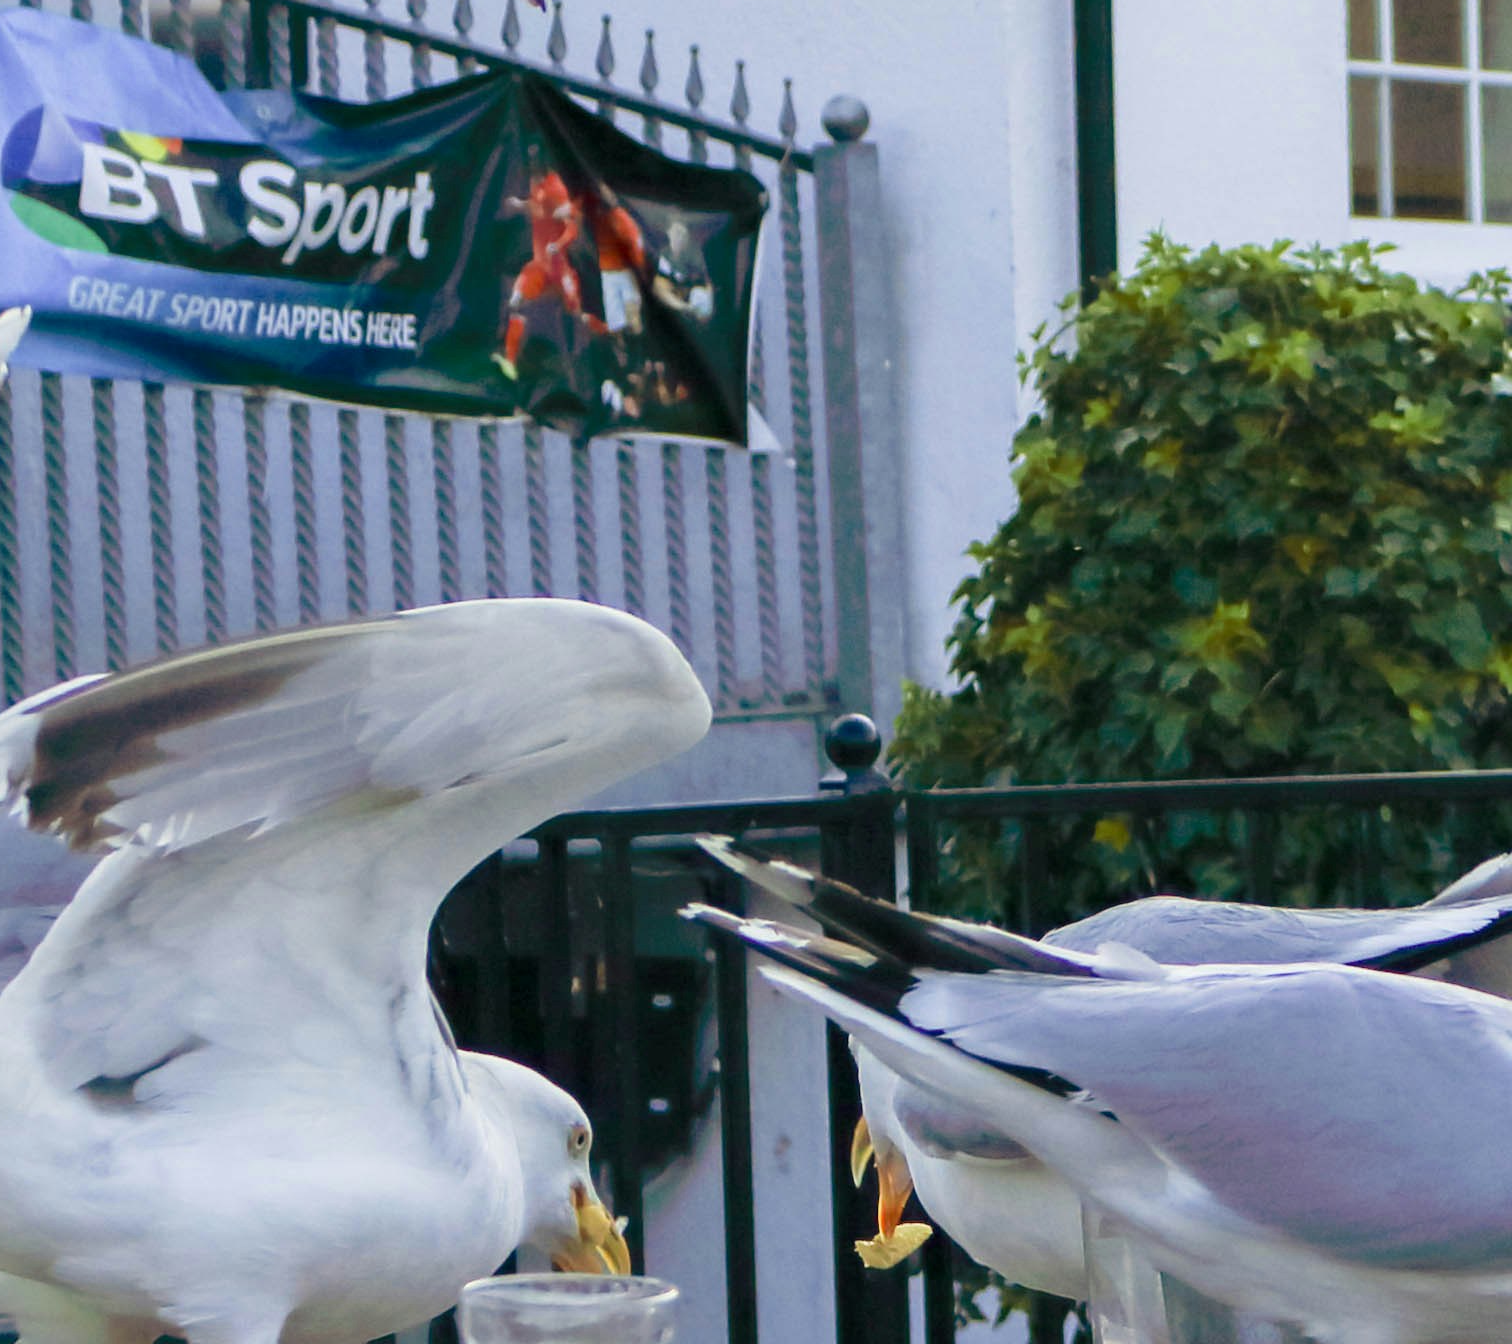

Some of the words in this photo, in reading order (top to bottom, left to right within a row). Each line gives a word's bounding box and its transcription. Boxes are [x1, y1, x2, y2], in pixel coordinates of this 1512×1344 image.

[79, 141, 220, 240] BT
[238, 159, 436, 266] Sport
[67, 274, 167, 322] GREAT
[165, 292, 255, 335] SPORT
[255, 301, 364, 346] HAPPENS
[364, 311, 418, 351] HERE
